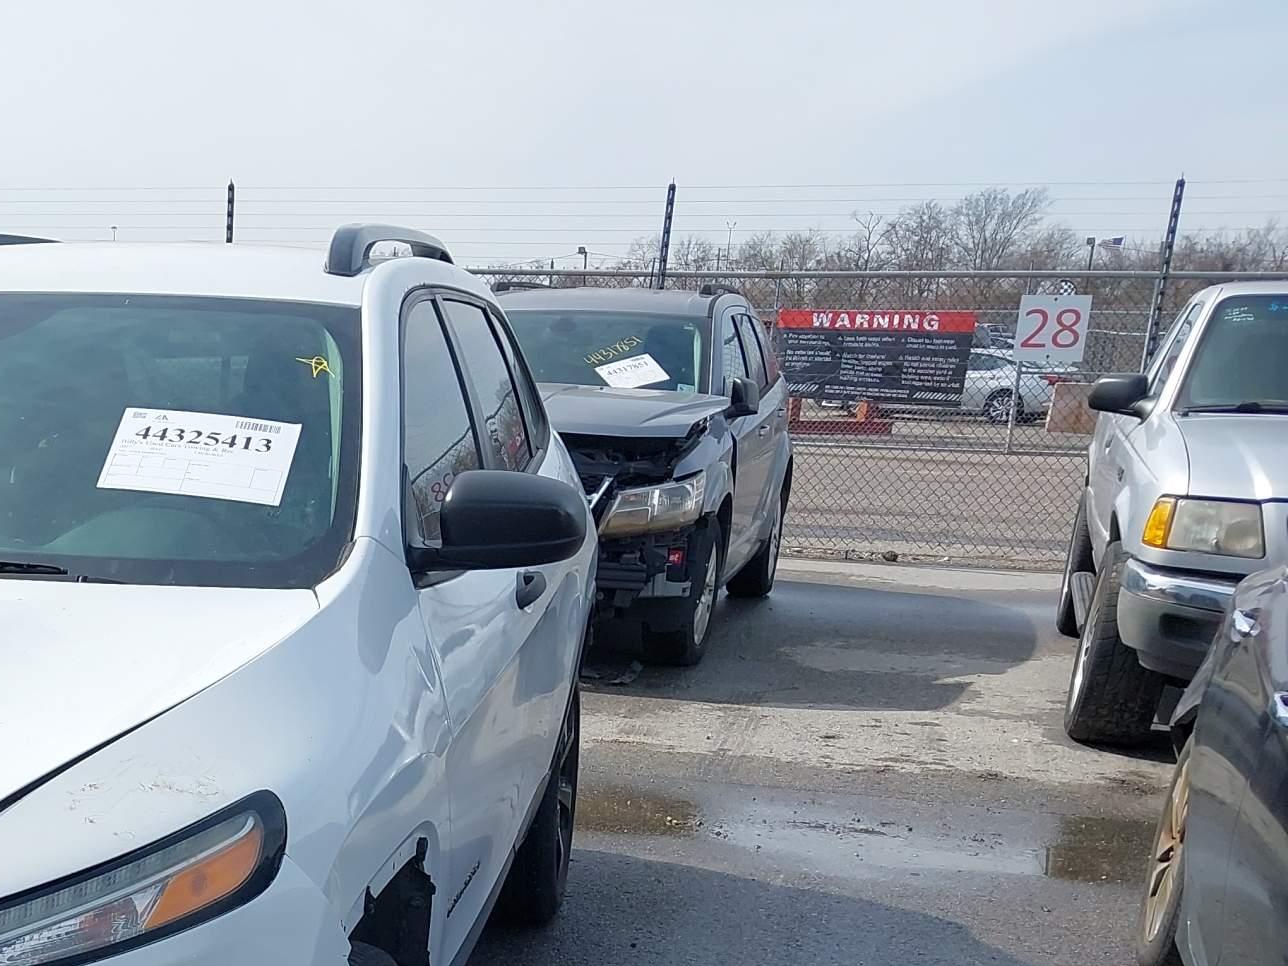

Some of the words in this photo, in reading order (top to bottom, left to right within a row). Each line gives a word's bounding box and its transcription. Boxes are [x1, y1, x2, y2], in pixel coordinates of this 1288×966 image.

[812, 312, 940, 330] WARNING
[1020, 308, 1081, 348] 28
[584, 336, 643, 366] 44317851
[606, 360, 649, 376] 44317851
[136, 426, 272, 453] 44325413
